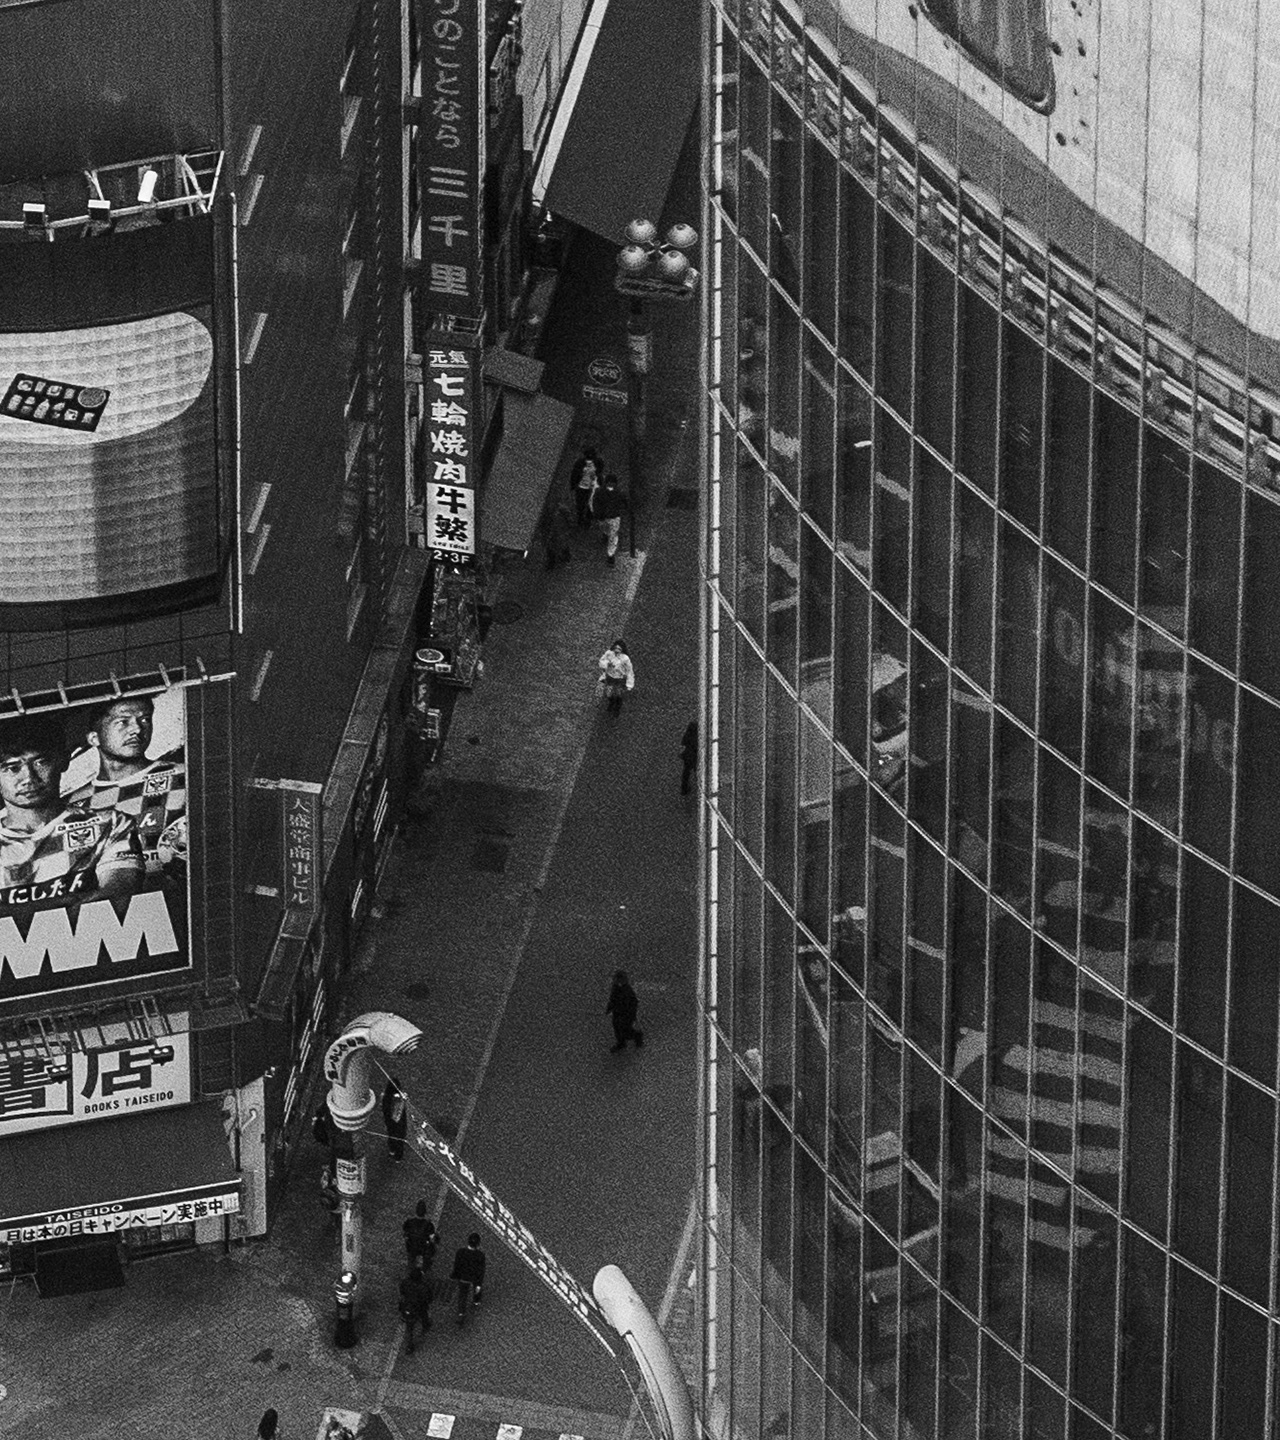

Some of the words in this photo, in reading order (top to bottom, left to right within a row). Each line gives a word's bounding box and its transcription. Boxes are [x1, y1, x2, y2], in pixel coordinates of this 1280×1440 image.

[428, 165, 470, 297] 三千里
[430, 372, 468, 484] 七輪焼肉
[435, 486, 469, 543] 牛繁
[9, 873, 84, 903] にしたん
[84, 1100, 120, 1115] BOOKS
[125, 1090, 174, 1108] TAISEIDO
[45, 1205, 123, 1224] TAISEIDO
